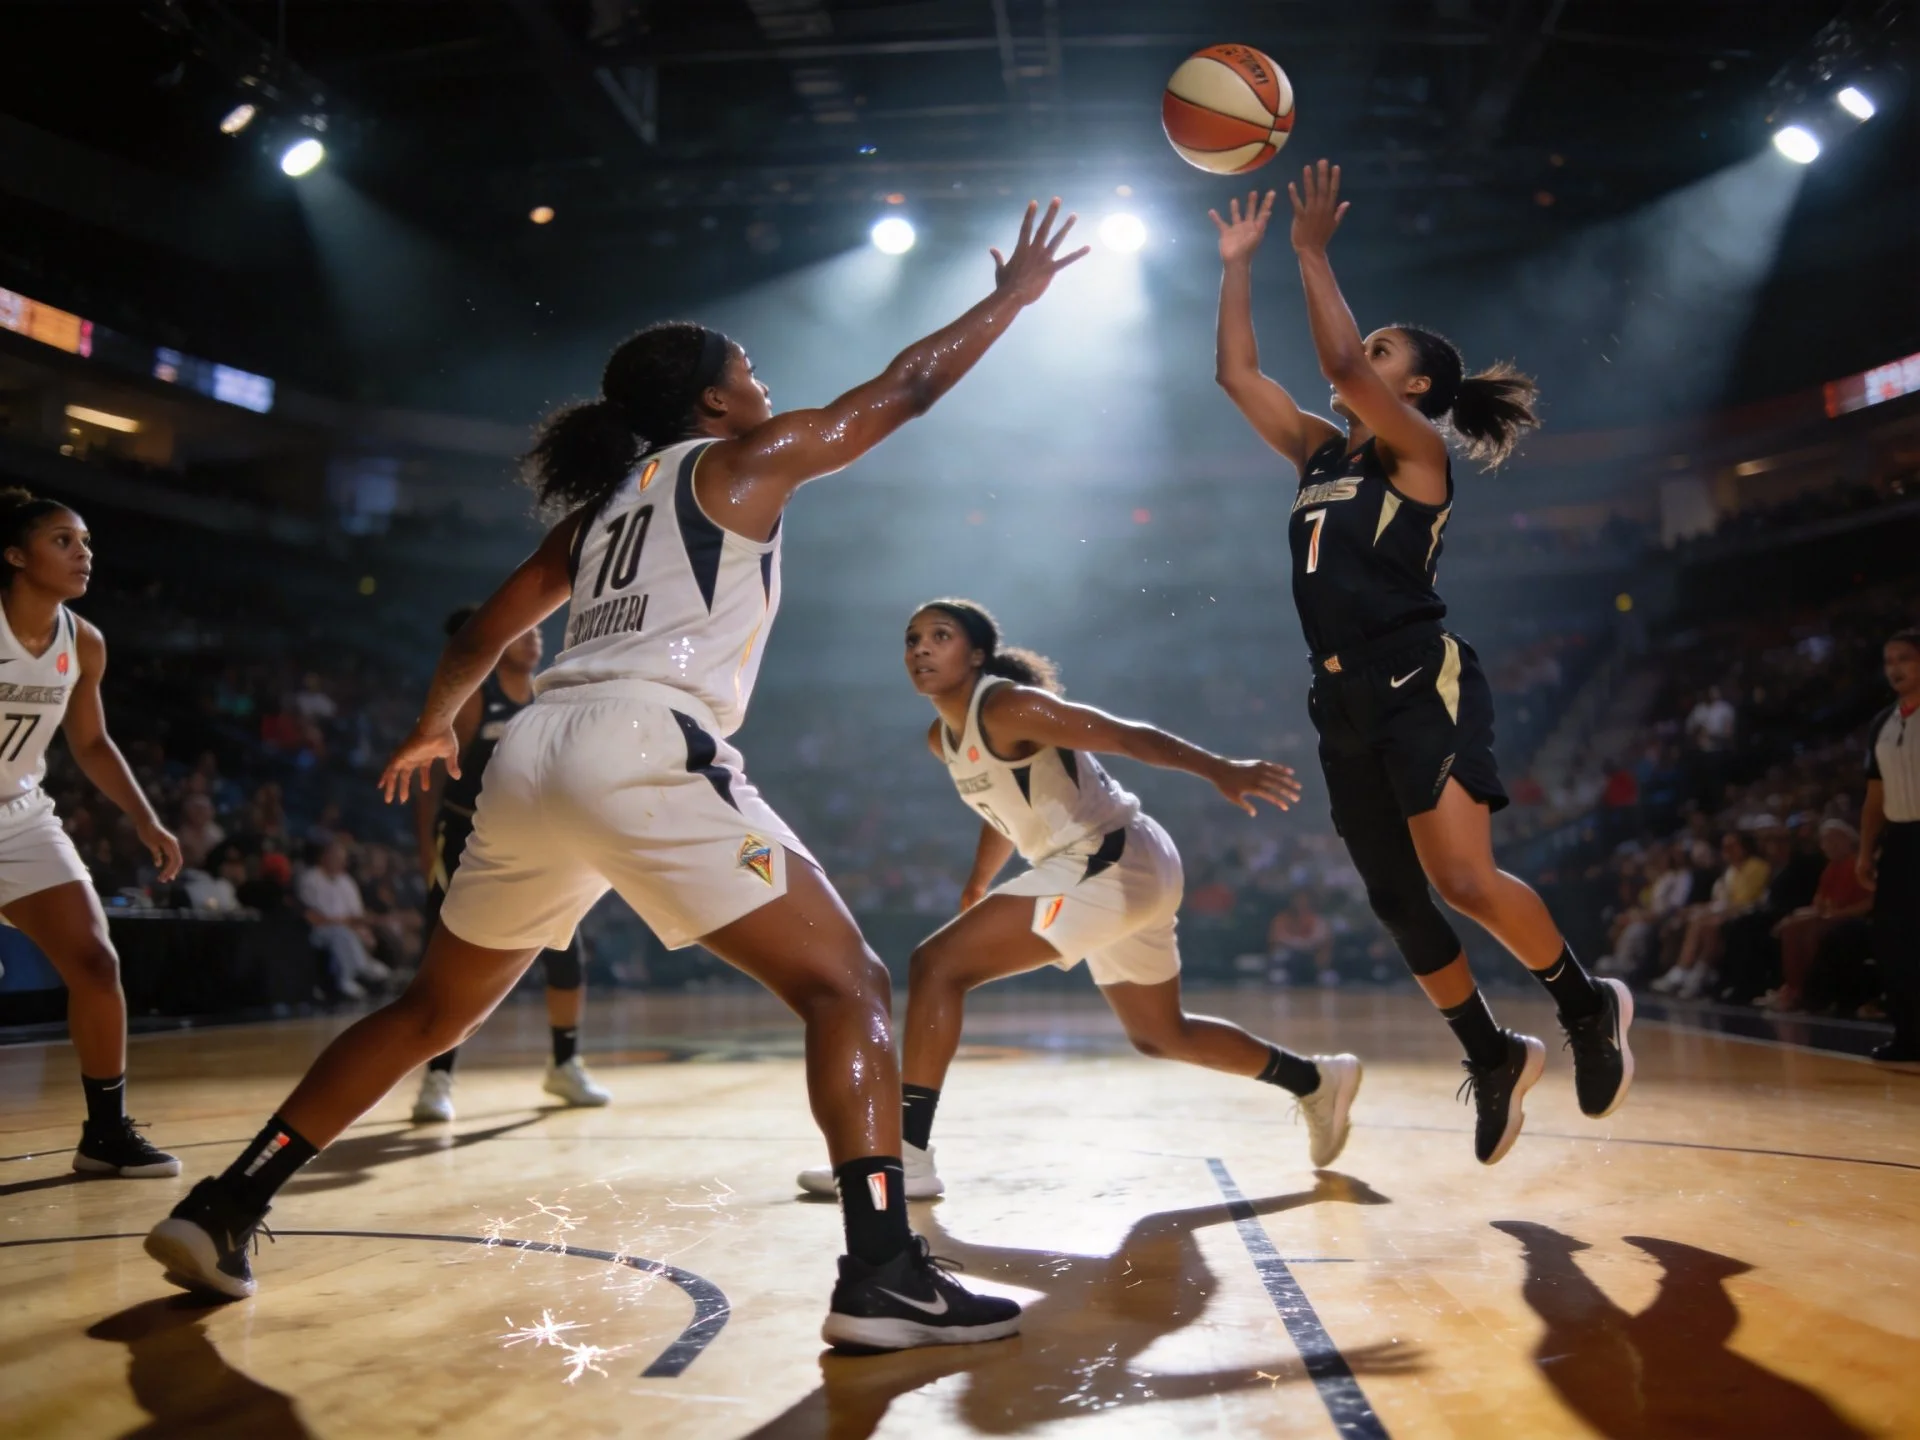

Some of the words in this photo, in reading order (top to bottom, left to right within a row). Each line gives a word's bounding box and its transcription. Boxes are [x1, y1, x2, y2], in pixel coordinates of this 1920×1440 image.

[593, 504, 653, 599] 10
[1304, 508, 1327, 574] 7
[0, 713, 41, 762] 77
